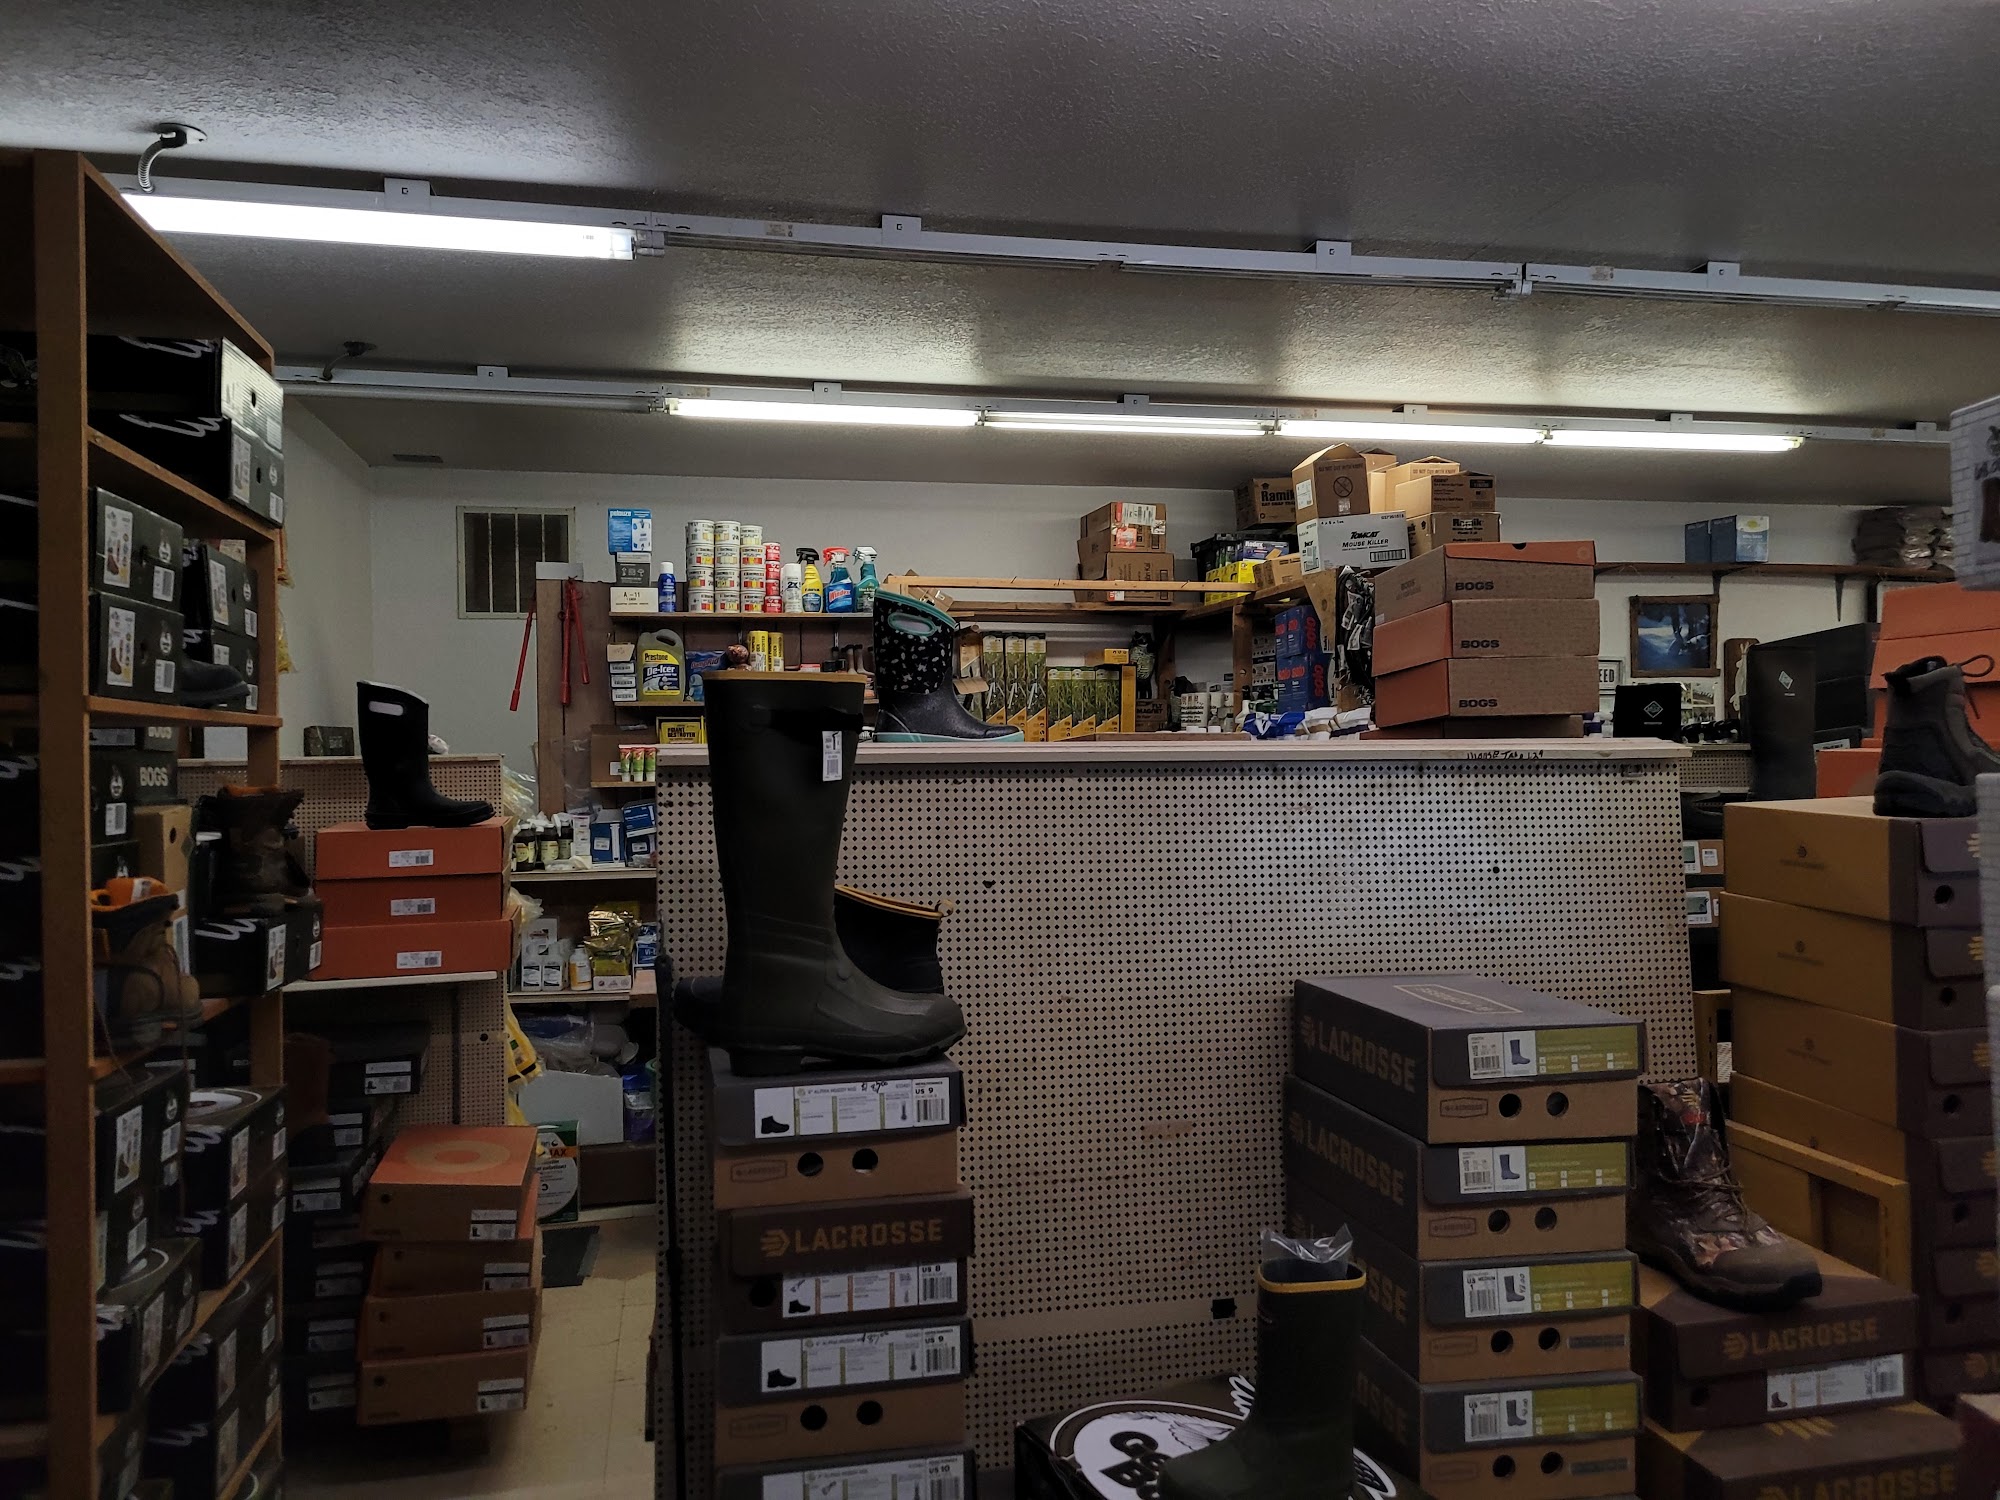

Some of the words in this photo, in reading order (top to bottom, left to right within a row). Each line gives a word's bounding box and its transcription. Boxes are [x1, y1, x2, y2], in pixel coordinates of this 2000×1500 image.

[1341, 540, 1365, 548] MOUSE
[1366, 538, 1389, 546] KILLER
[1455, 581, 1494, 591] BOGS
[829, 589, 852, 603] Windex
[1460, 639, 1500, 649] BOGS
[644, 653, 669, 661] Prestone
[646, 664, 676, 676] De-Icer
[1458, 699, 1498, 708] BOGS
[140, 766, 169, 787] BOGS
[1318, 1020, 1417, 1094] LACROSSE
[1307, 1119, 1407, 1206] LACROSSE
[795, 1217, 944, 1254] LACROSSE
[1752, 1317, 1880, 1356] LACROSSE
[940, 1464, 951, 1473] 10
[1793, 1463, 1956, 1500] LACROSSE
